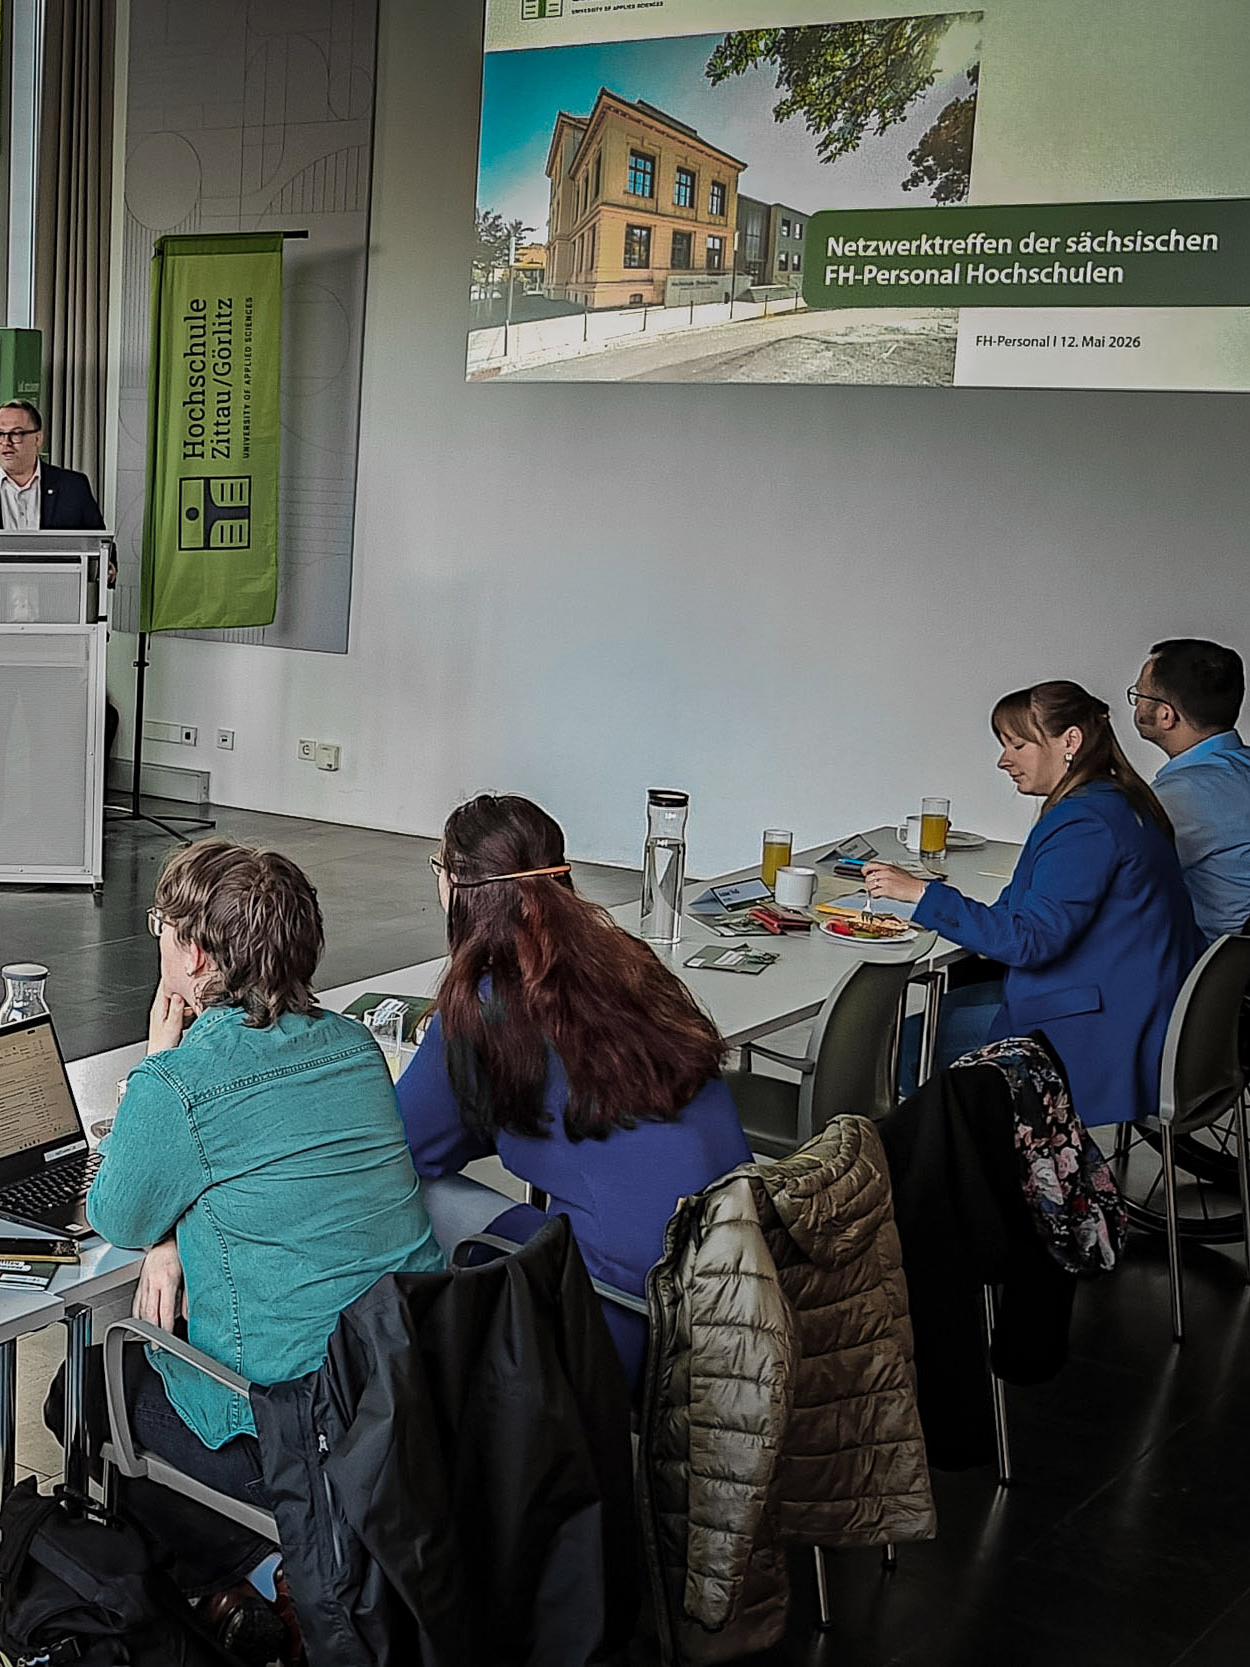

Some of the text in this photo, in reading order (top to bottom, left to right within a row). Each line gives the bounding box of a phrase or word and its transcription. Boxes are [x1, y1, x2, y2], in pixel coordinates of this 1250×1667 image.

[825, 261, 1124, 286] FH-Personal Hochschulen
[826, 229, 1219, 257] Netzwerktreffen der sächsischen
[183, 298, 207, 460] Hochschule
[210, 297, 233, 459] Zittau/Görlitz
[242, 297, 254, 459] UNIVERSITY OF APPLIED SCIENCES
[975, 335, 1050, 348] FH-Personal
[1060, 336, 1079, 348] 12.
[1081, 335, 1106, 348] Mai
[1108, 336, 1142, 348] 2026
